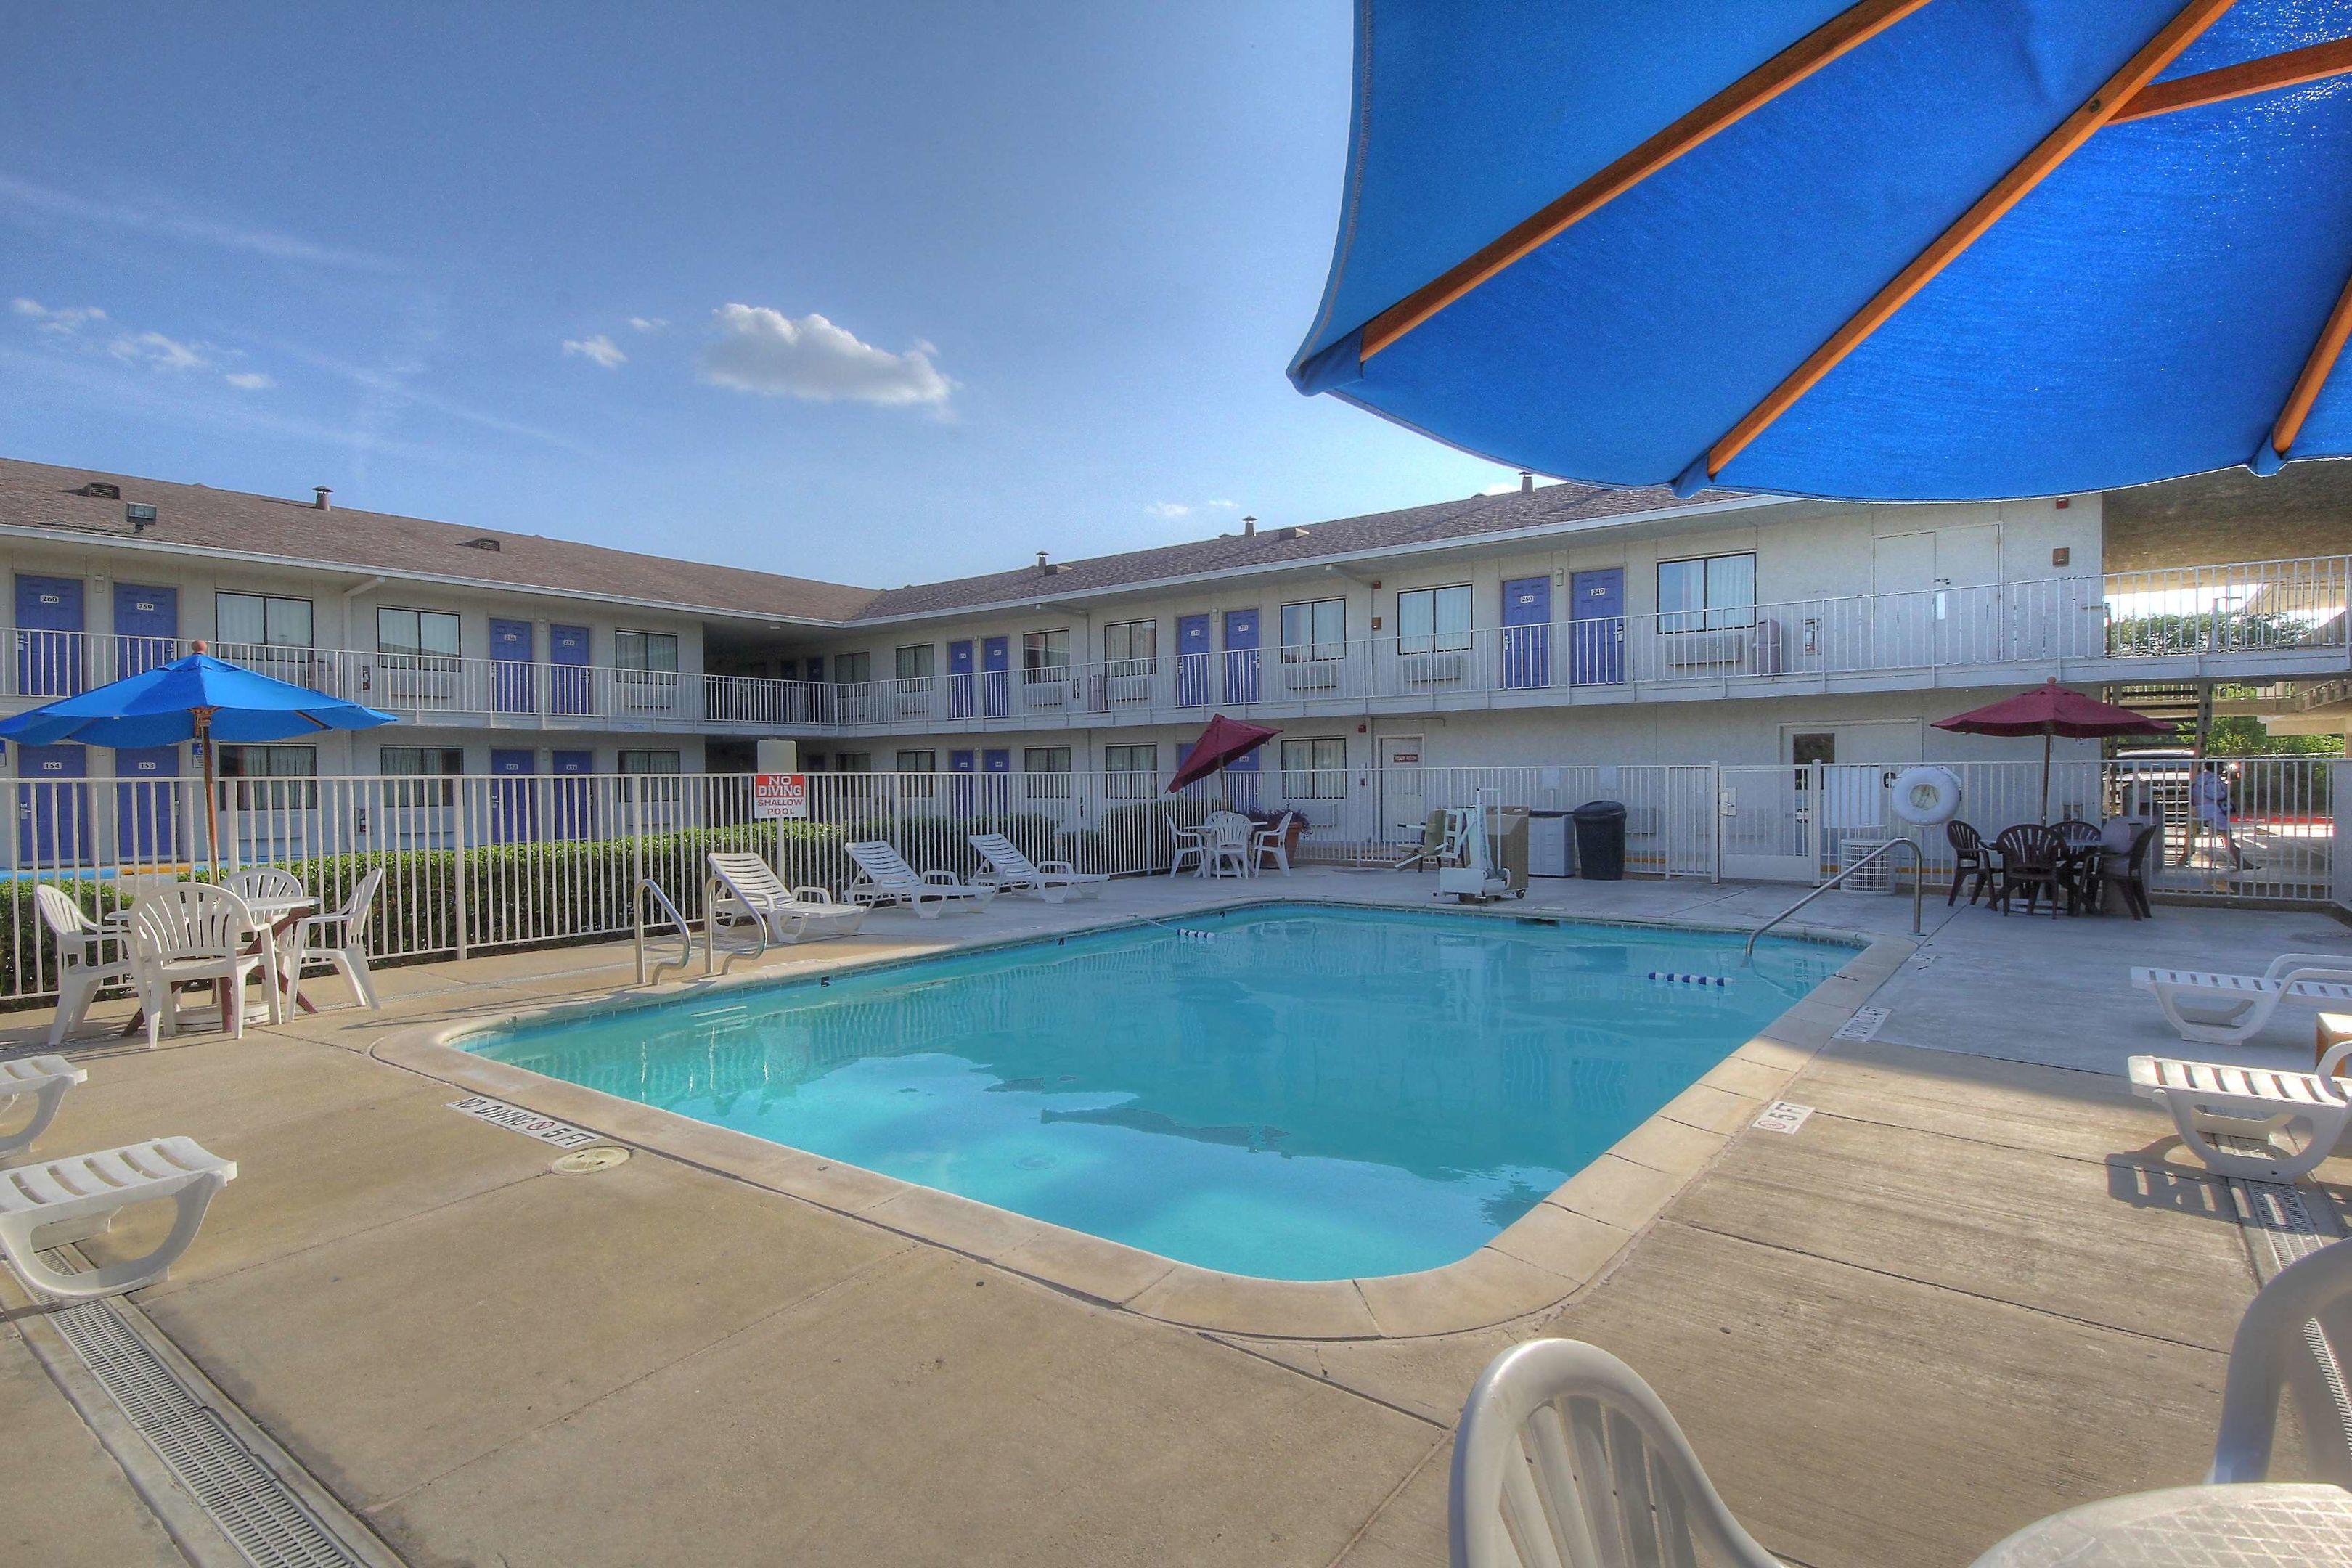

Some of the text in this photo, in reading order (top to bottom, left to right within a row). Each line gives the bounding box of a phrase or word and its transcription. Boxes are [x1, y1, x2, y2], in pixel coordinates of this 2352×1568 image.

[769, 775, 791, 785] NO
[758, 785, 802, 796] DIVING
[821, 976, 830, 987] 5
[1768, 1102, 1809, 1121] 5 FT
[452, 1097, 596, 1146] NO DIVING 5 FT
